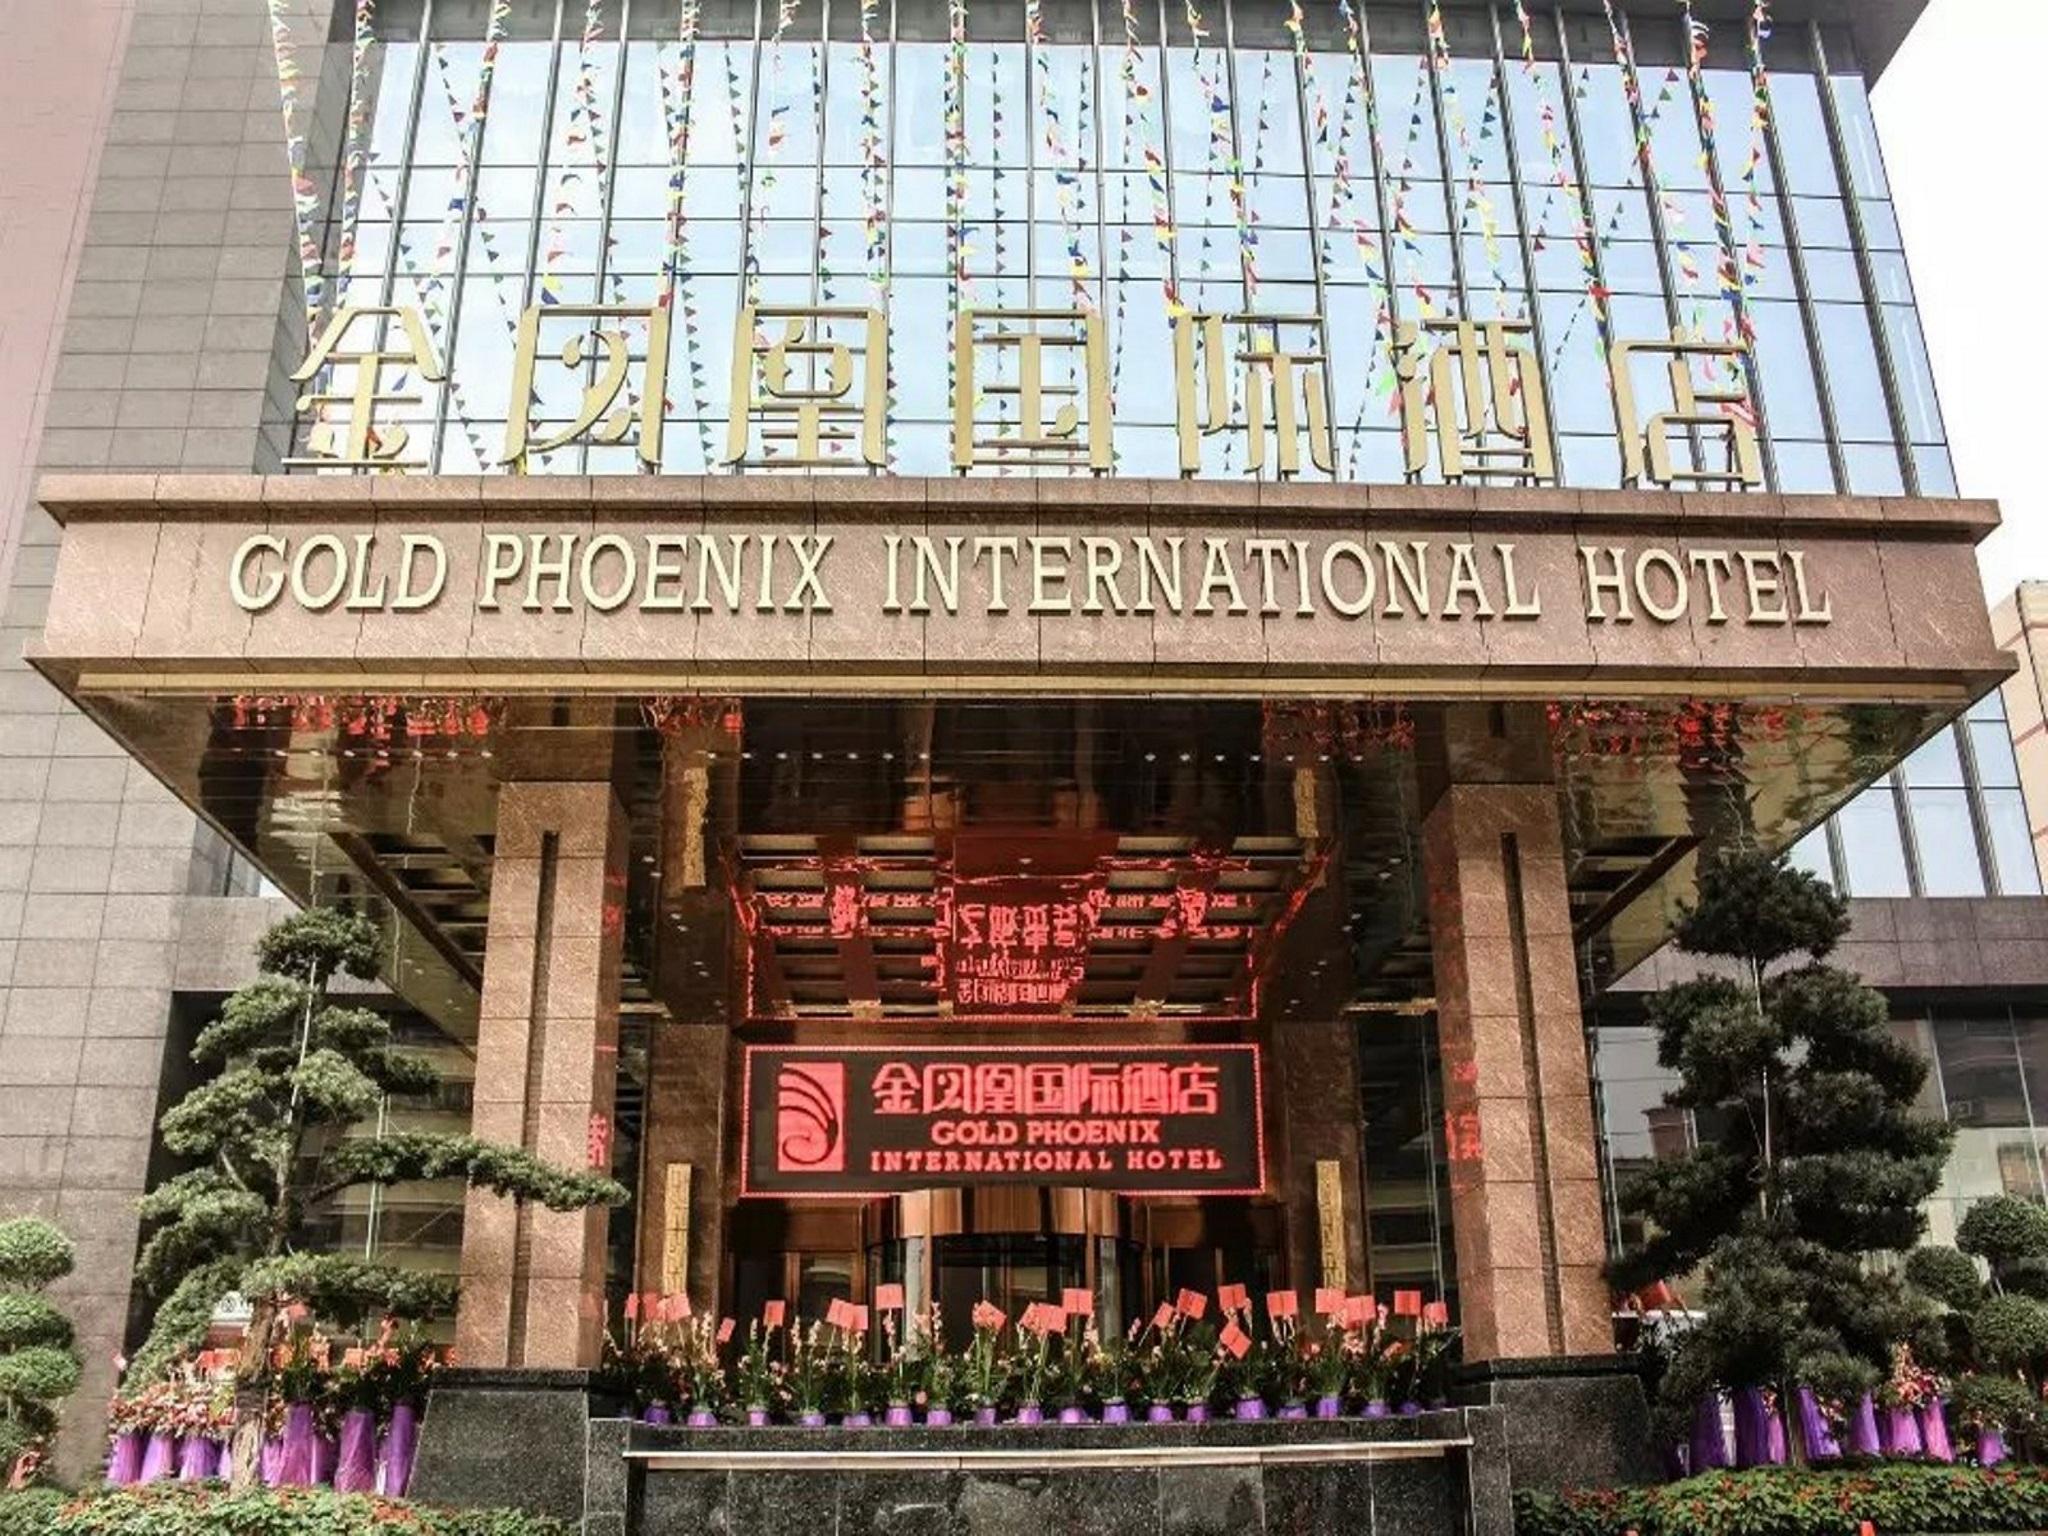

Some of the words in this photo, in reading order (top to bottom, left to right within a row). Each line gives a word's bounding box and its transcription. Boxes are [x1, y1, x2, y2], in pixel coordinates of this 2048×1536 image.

[281, 305, 1762, 484] 金凤凰国际酒店
[229, 534, 448, 611] GOLD
[479, 533, 834, 612] PHOENIX
[882, 534, 1542, 619] INTERNATIONAL
[1579, 545, 1833, 625] HOTEL
[872, 1062, 1220, 1115] 金凤凰国际酒店
[931, 1120, 1018, 1146] GOLD
[1026, 1120, 1160, 1145] PHOENIX
[870, 1151, 1112, 1171] INTERNATIONAL
[1126, 1149, 1222, 1171] HOTEL
